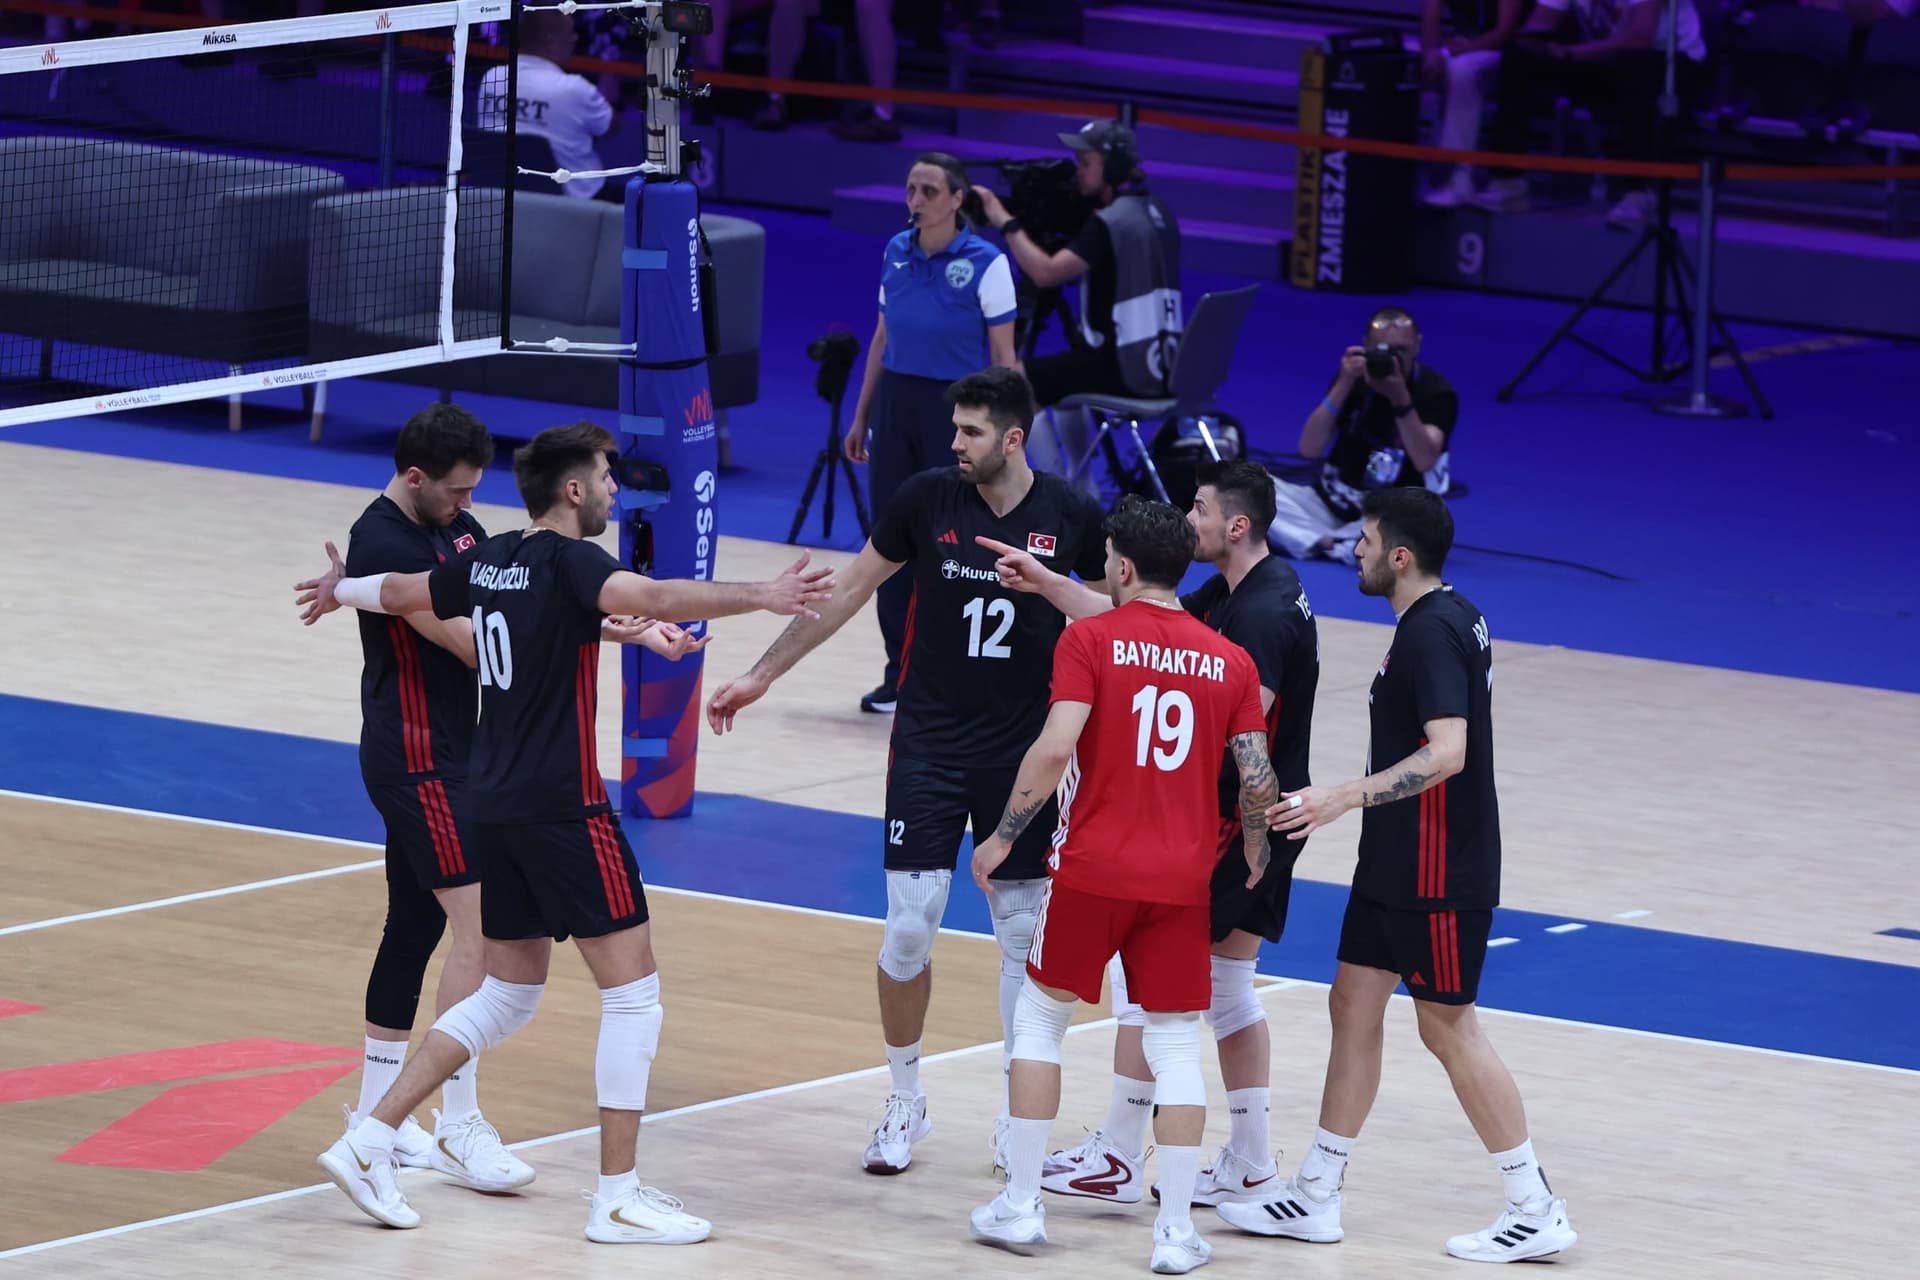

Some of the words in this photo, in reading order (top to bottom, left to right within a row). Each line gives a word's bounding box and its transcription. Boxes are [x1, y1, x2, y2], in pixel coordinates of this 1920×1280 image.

[688, 239, 700, 313] Senoh
[1457, 231, 1484, 275] 9
[472, 605, 513, 690] 10
[963, 596, 1015, 659] 12
[1112, 639, 1226, 683] BAYRAKTAR
[1131, 684, 1195, 772] 19
[889, 819, 905, 846] 12
[366, 1054, 399, 1065] adidas
